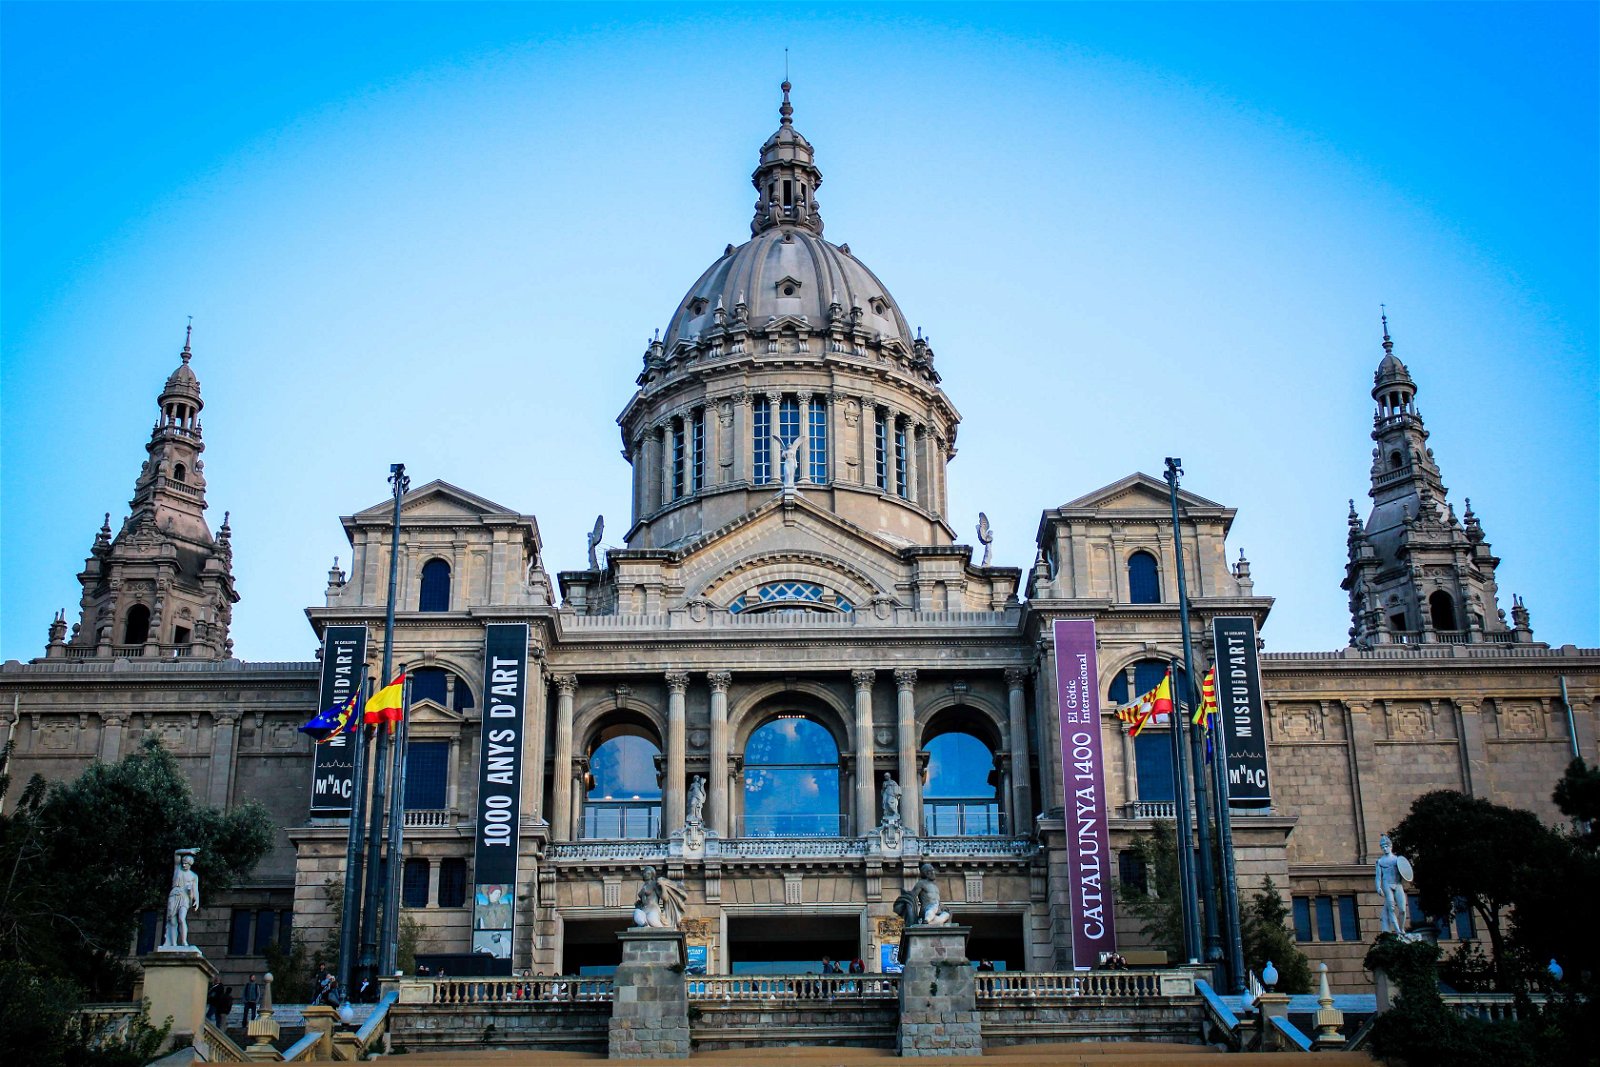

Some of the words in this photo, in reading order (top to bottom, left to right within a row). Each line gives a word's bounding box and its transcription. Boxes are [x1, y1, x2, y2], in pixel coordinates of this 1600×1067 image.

[335, 646, 353, 687] D'ART
[1228, 637, 1247, 678] D'ART
[490, 655, 519, 718] D'ART
[1076, 653, 1091, 724] Internacional
[1067, 711, 1079, 724] El
[1232, 687, 1252, 738] MUSEU
[487, 729, 516, 785] ANYS
[1072, 732, 1094, 781] 1400
[1229, 764, 1267, 789] MNAC
[315, 774, 352, 799] MNAC
[484, 795, 512, 847] 1000
[1075, 785, 1104, 940] CATALUNYA
